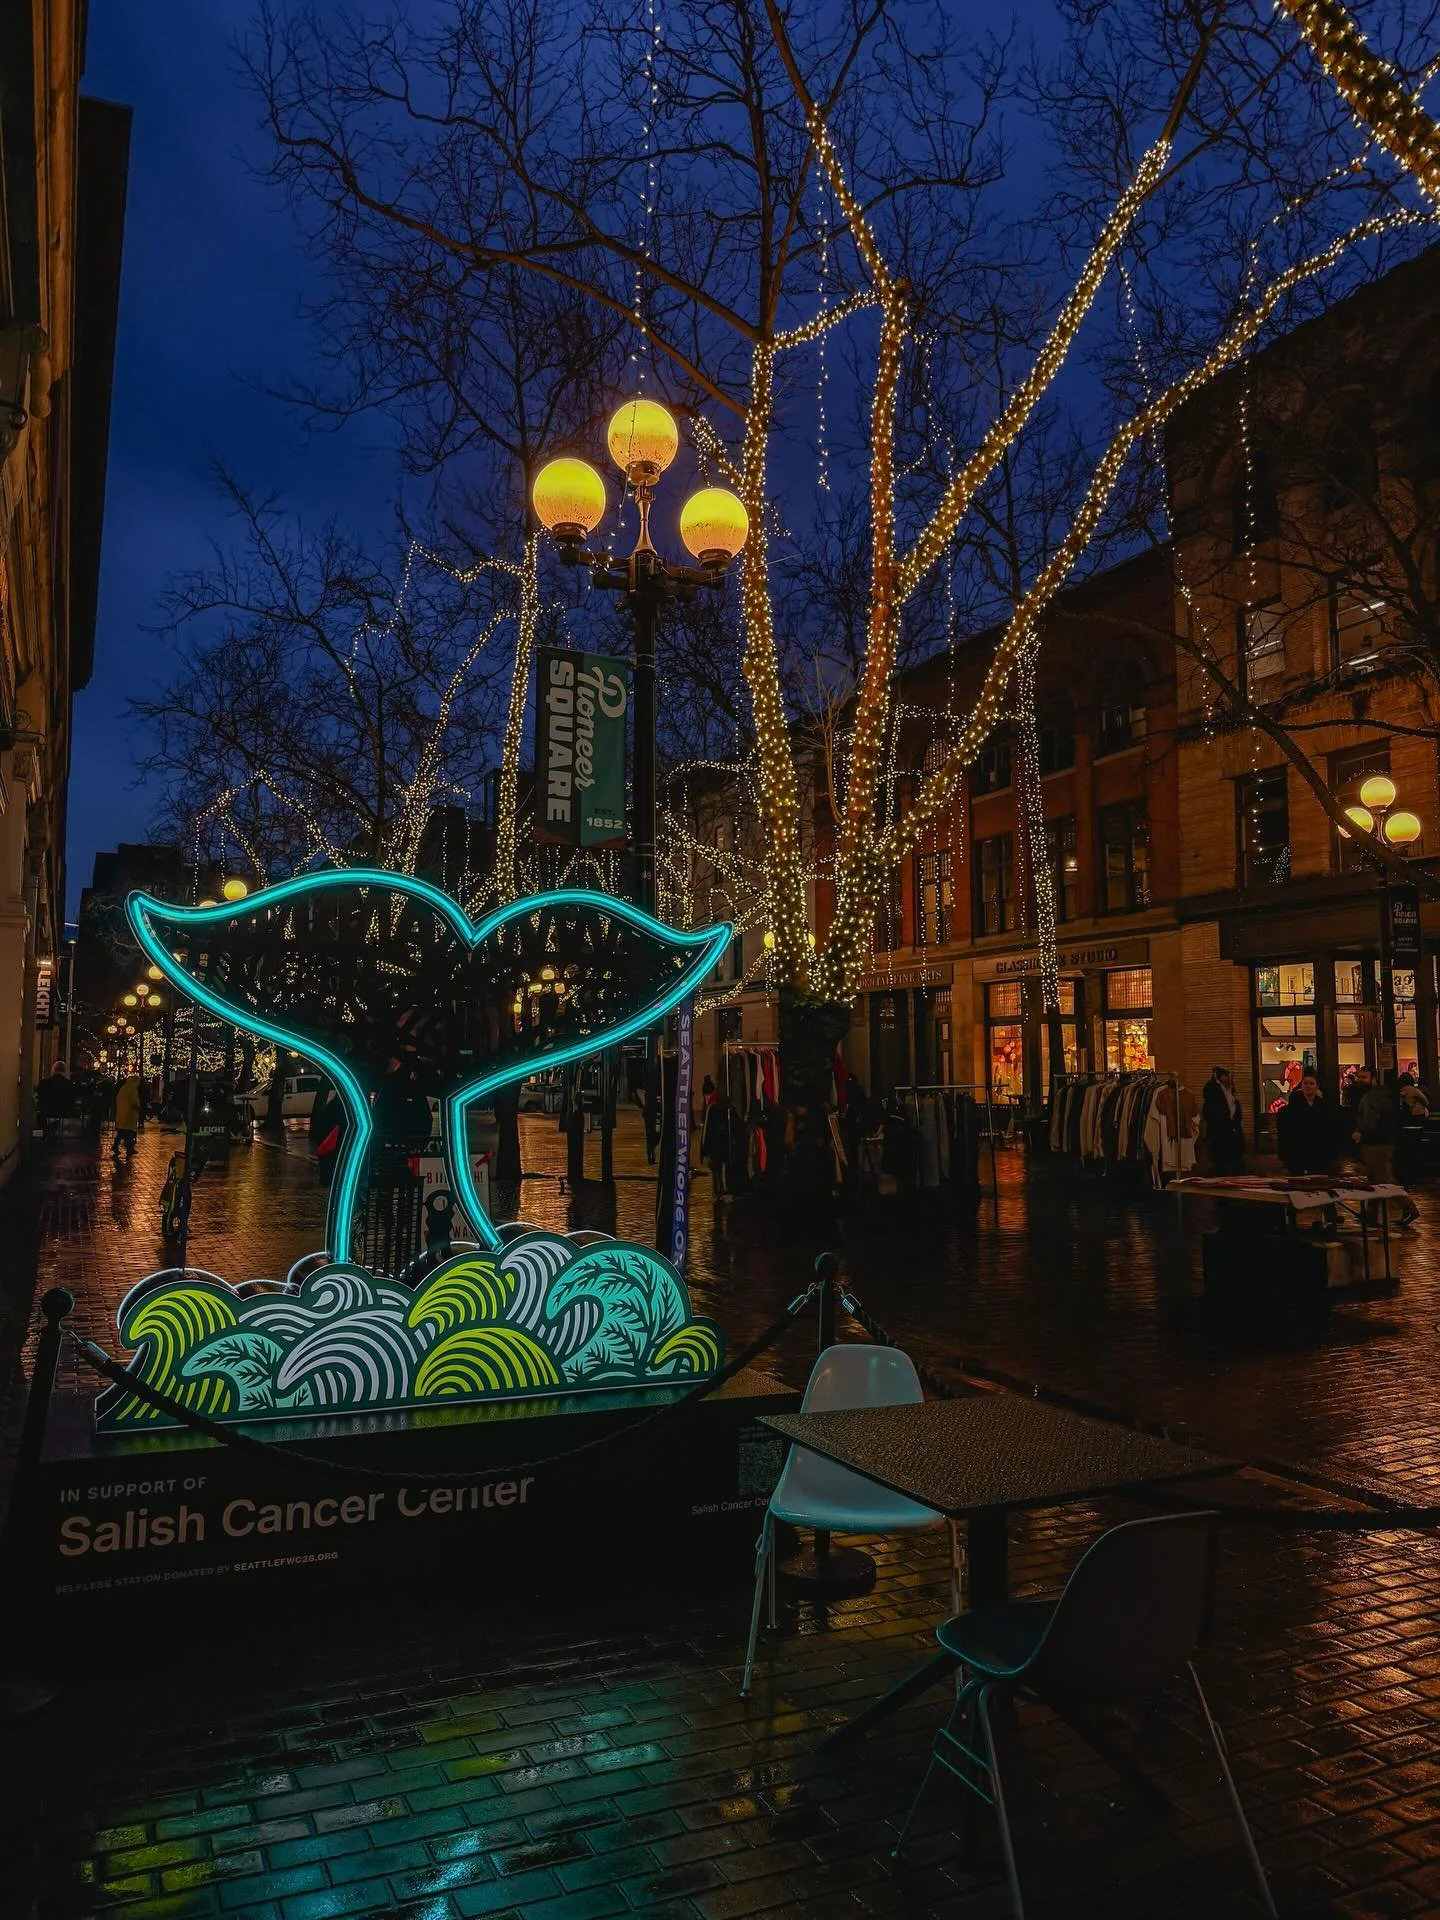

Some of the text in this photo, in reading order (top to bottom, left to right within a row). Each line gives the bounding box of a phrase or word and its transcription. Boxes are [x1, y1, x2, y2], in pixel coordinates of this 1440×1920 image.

[575, 666, 626, 791] Pioneer
[546, 659, 575, 823] SQUARE
[586, 816, 624, 829] 1852
[1070, 948, 1118, 965] STUDIO
[893, 971, 915, 984] FINE
[919, 968, 943, 981] ARTS
[60, 1475, 208, 1504] IN SUPPORT OF
[58, 1475, 536, 1557] Salish Cancer Center
[720, 1500, 753, 1513] Cancer
[114, 1573, 162, 1588] STATION
[163, 1566, 214, 1581] DONATED
